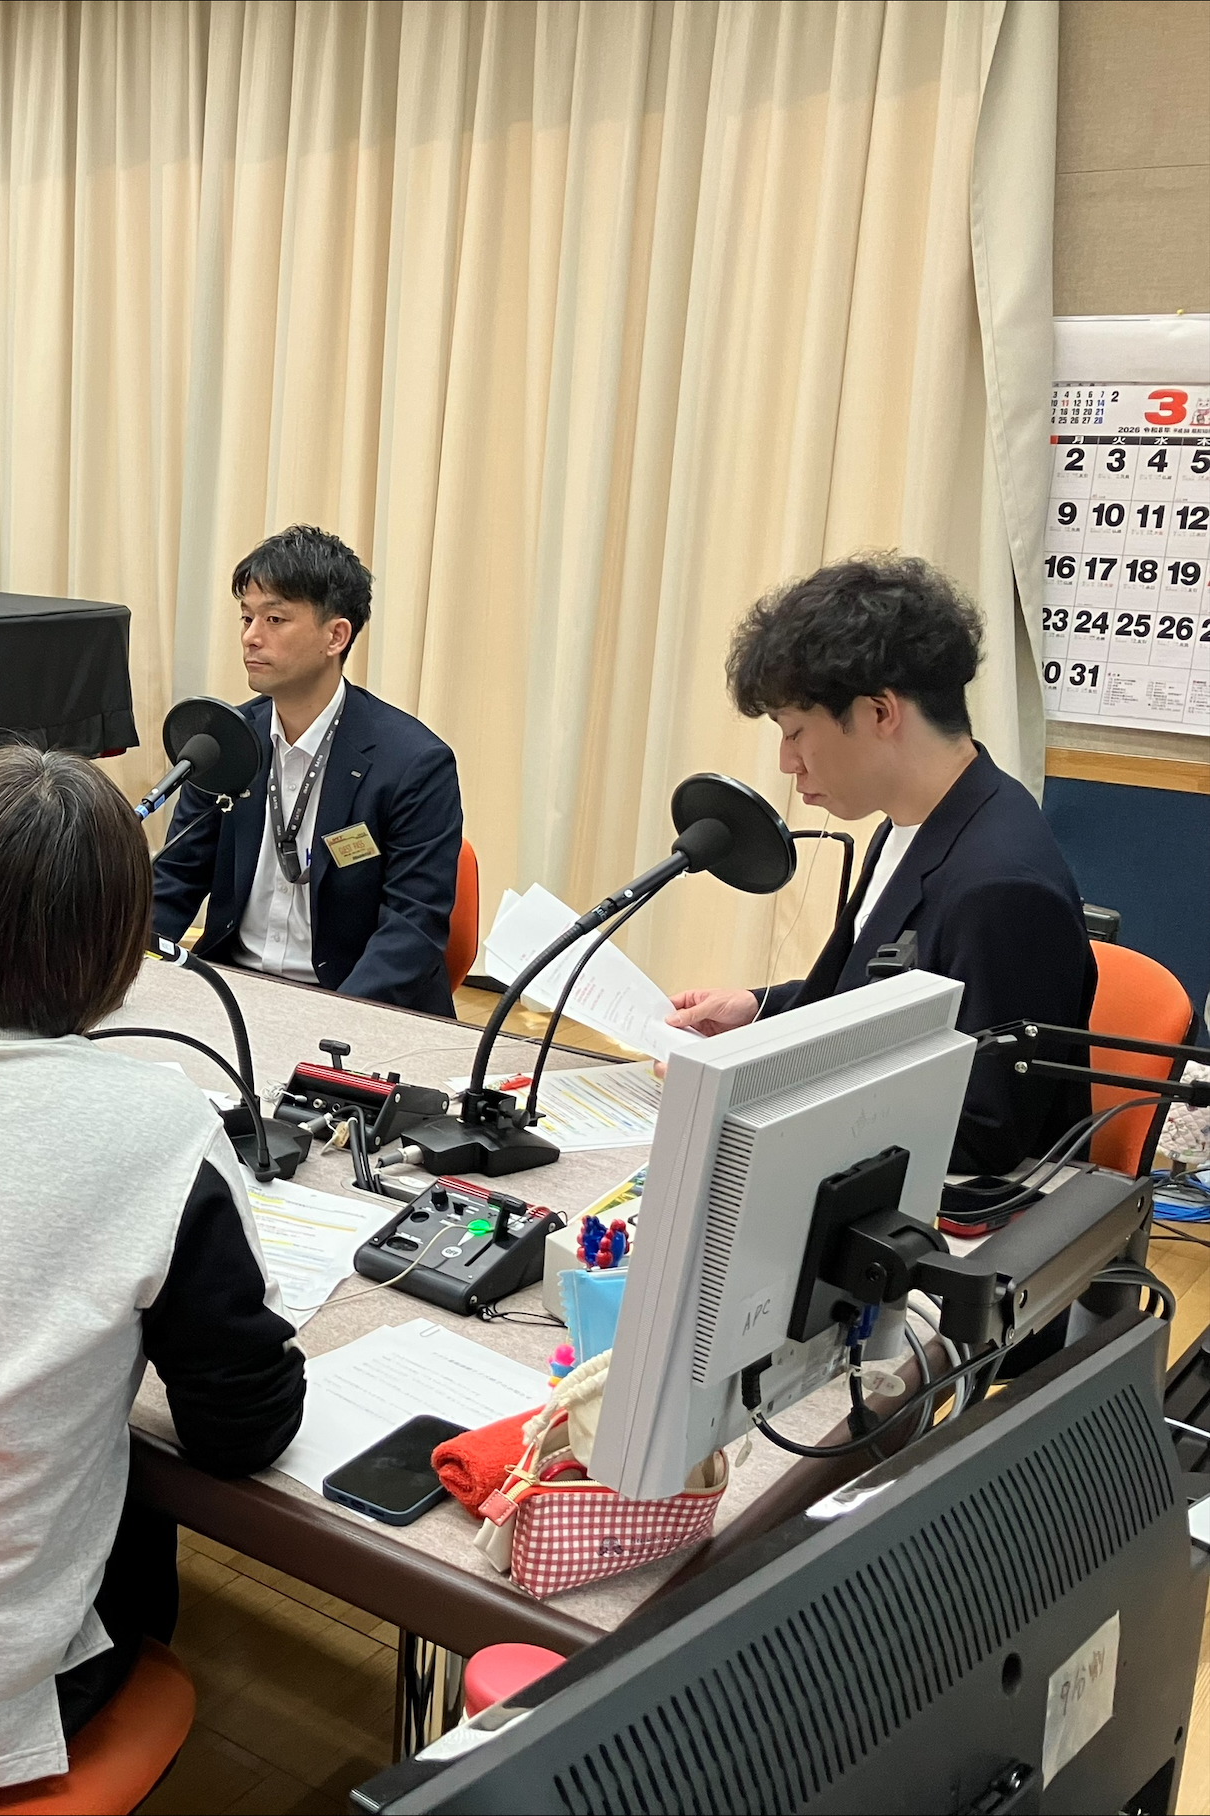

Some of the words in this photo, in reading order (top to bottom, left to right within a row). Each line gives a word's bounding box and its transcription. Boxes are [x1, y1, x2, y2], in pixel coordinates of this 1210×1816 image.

[1052, 390, 1058, 398] 3
[1088, 391, 1093, 399] 6
[1111, 391, 1120, 402] 2
[1144, 388, 1189, 425] 3
[1060, 408, 1068, 416] 18
[1072, 408, 1080, 416] 19
[1083, 408, 1092, 416] 20
[1095, 408, 1104, 416] 21
[1072, 436, 1085, 444] 月
[1154, 437, 1168, 445] 水
[1197, 437, 1210, 445] 木
[1064, 447, 1085, 471] 2
[1106, 448, 1126, 472] 3
[1147, 448, 1168, 472] 4
[1190, 449, 1210, 474] 5
[1057, 501, 1077, 525] 9
[1092, 503, 1125, 527] 10
[1136, 504, 1165, 528] 11
[1176, 505, 1210, 530] 12
[1044, 555, 1076, 579] 16
[1085, 557, 1118, 581] 17
[1125, 559, 1158, 583] 18
[1167, 561, 1201, 586] 19
[1042, 607, 1069, 632] 23
[1074, 610, 1109, 634] 24
[1115, 613, 1151, 637] 25
[1156, 615, 1194, 641] 26
[1042, 660, 1061, 684] 0
[1069, 663, 1100, 687] 31
[742, 1298, 771, 1336] APC
